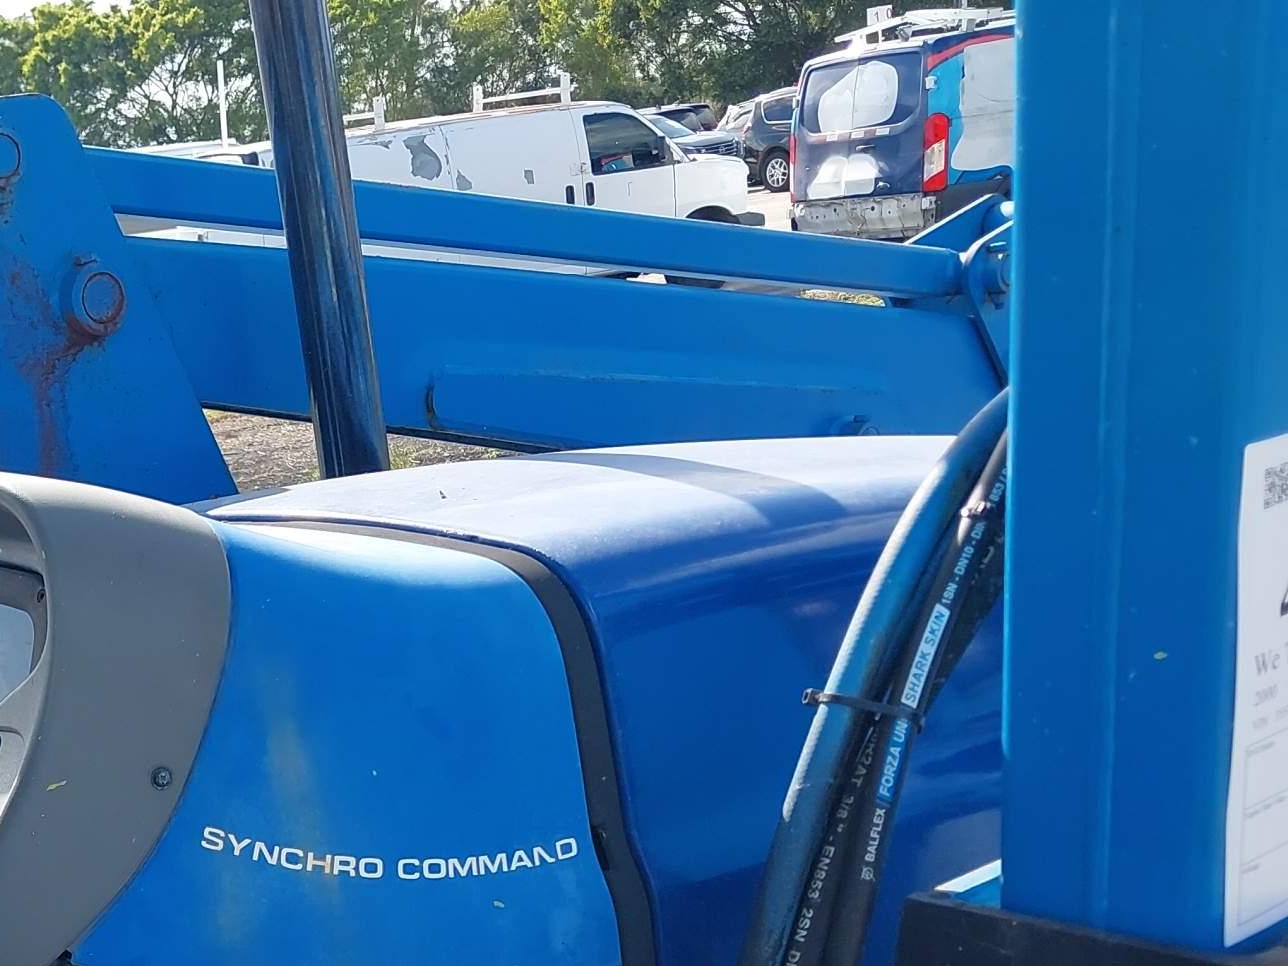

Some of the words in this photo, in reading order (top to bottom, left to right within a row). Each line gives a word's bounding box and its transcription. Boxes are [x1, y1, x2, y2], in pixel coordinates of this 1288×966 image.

[953, 546, 973, 576] DN10
[905, 651, 931, 703] SHARK
[924, 610, 946, 648] SKIN
[865, 808, 887, 862] BALFLEX
[879, 746, 901, 797] FORZA
[894, 718, 909, 743] UN
[200, 825, 383, 880] SYNCHRO
[396, 836, 580, 881] COMMAND
[807, 844, 835, 900] EN853
[793, 908, 814, 943] 2SN
